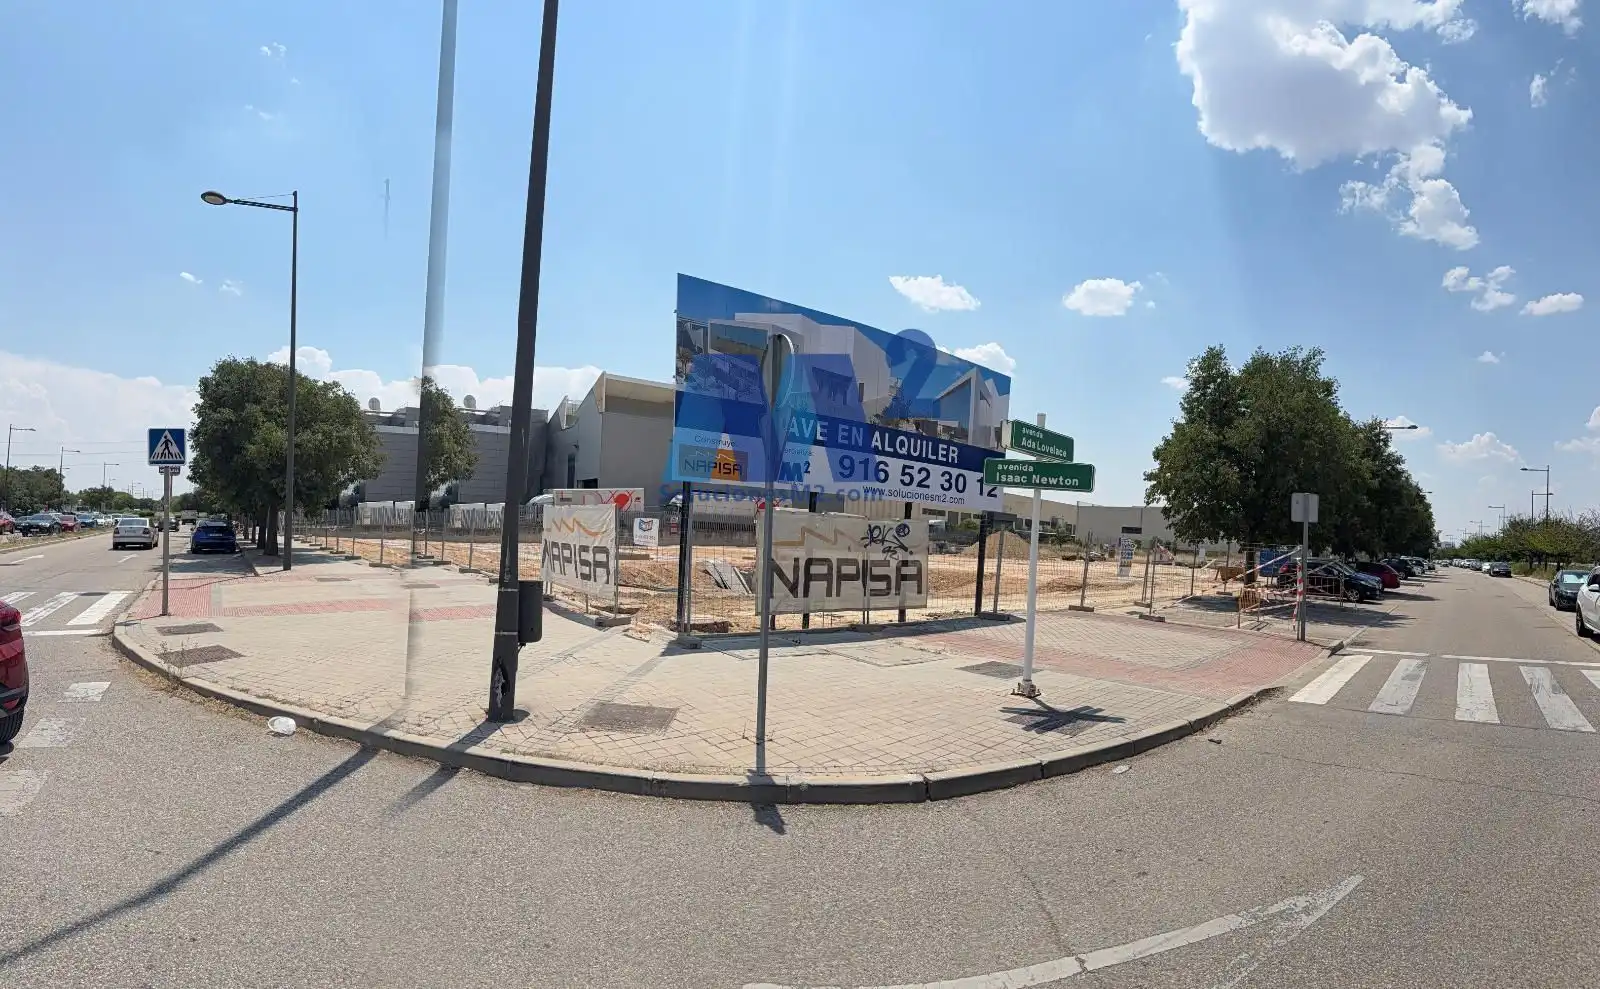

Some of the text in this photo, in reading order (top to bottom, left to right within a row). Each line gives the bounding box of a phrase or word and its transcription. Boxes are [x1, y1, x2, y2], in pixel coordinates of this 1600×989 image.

[786, 416, 959, 464] AVE EN ALQUILER
[1021, 437, 1067, 458] Ada Lovelace
[683, 459, 743, 477] NAPISA
[838, 454, 890, 484] 916
[900, 464, 931, 489] 52
[940, 471, 967, 494] 30
[997, 463, 1034, 472] avenida
[996, 473, 1079, 486] Isaac Newton
[862, 485, 966, 506] www.solucionesm2.com
[541, 538, 611, 585] NAPISA
[771, 557, 923, 599] NAPISA
